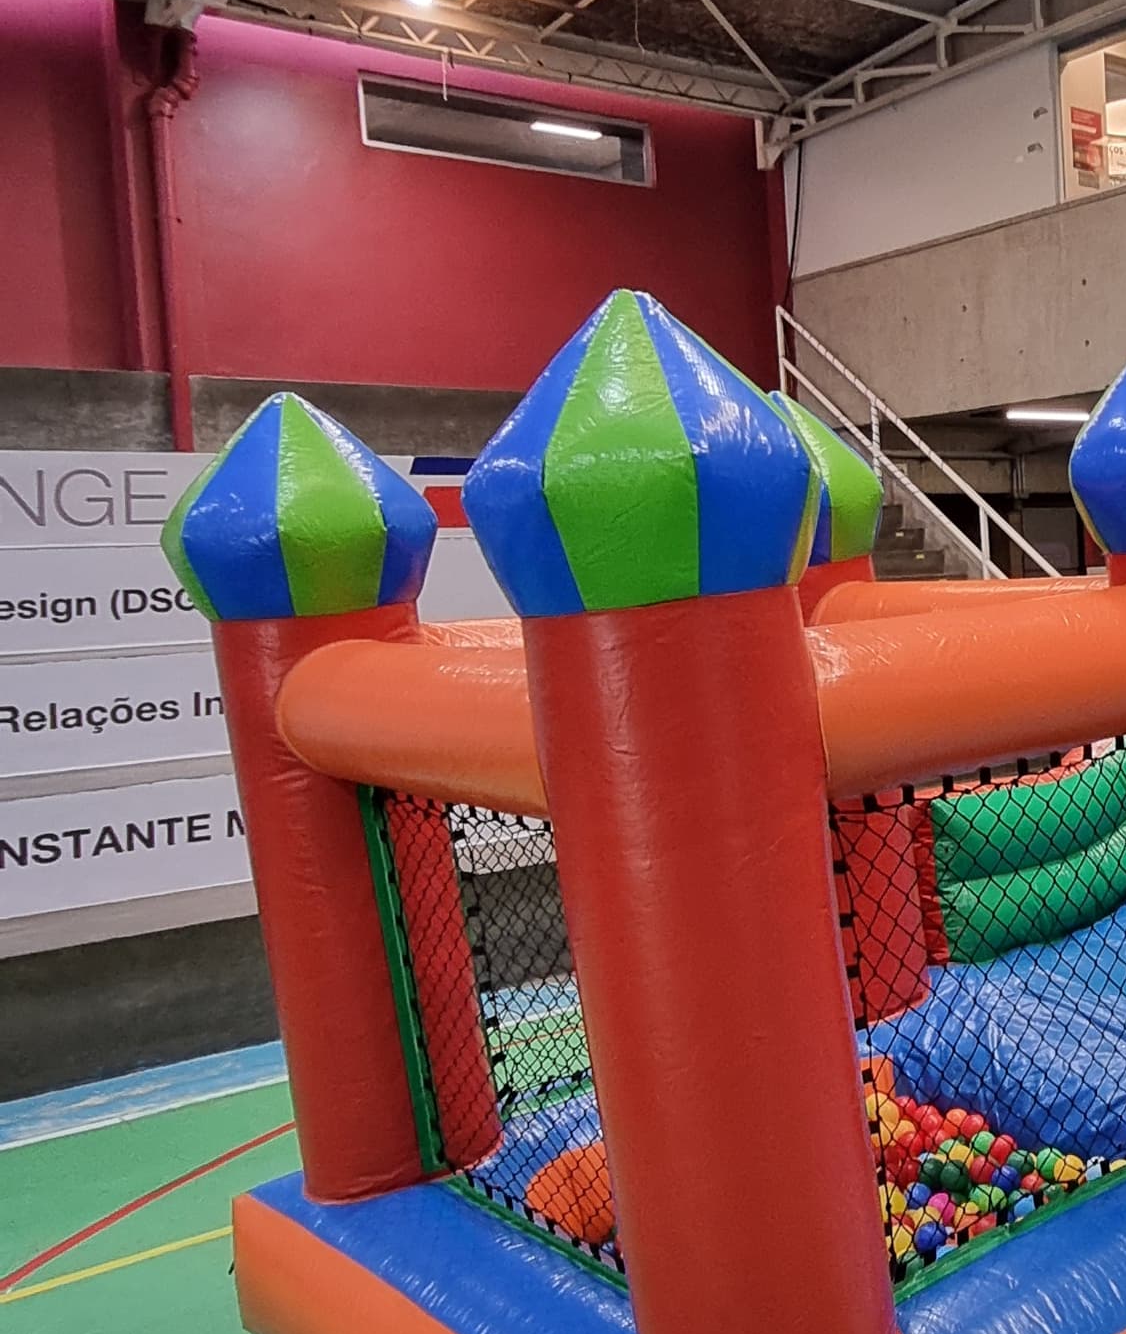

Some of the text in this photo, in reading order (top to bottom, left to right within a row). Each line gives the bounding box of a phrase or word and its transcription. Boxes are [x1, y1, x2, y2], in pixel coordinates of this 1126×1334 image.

[0, 469, 168, 527] NGE
[0, 592, 97, 623] esign
[0, 691, 225, 734] Relações In
[0, 813, 212, 868] NSTANTE
